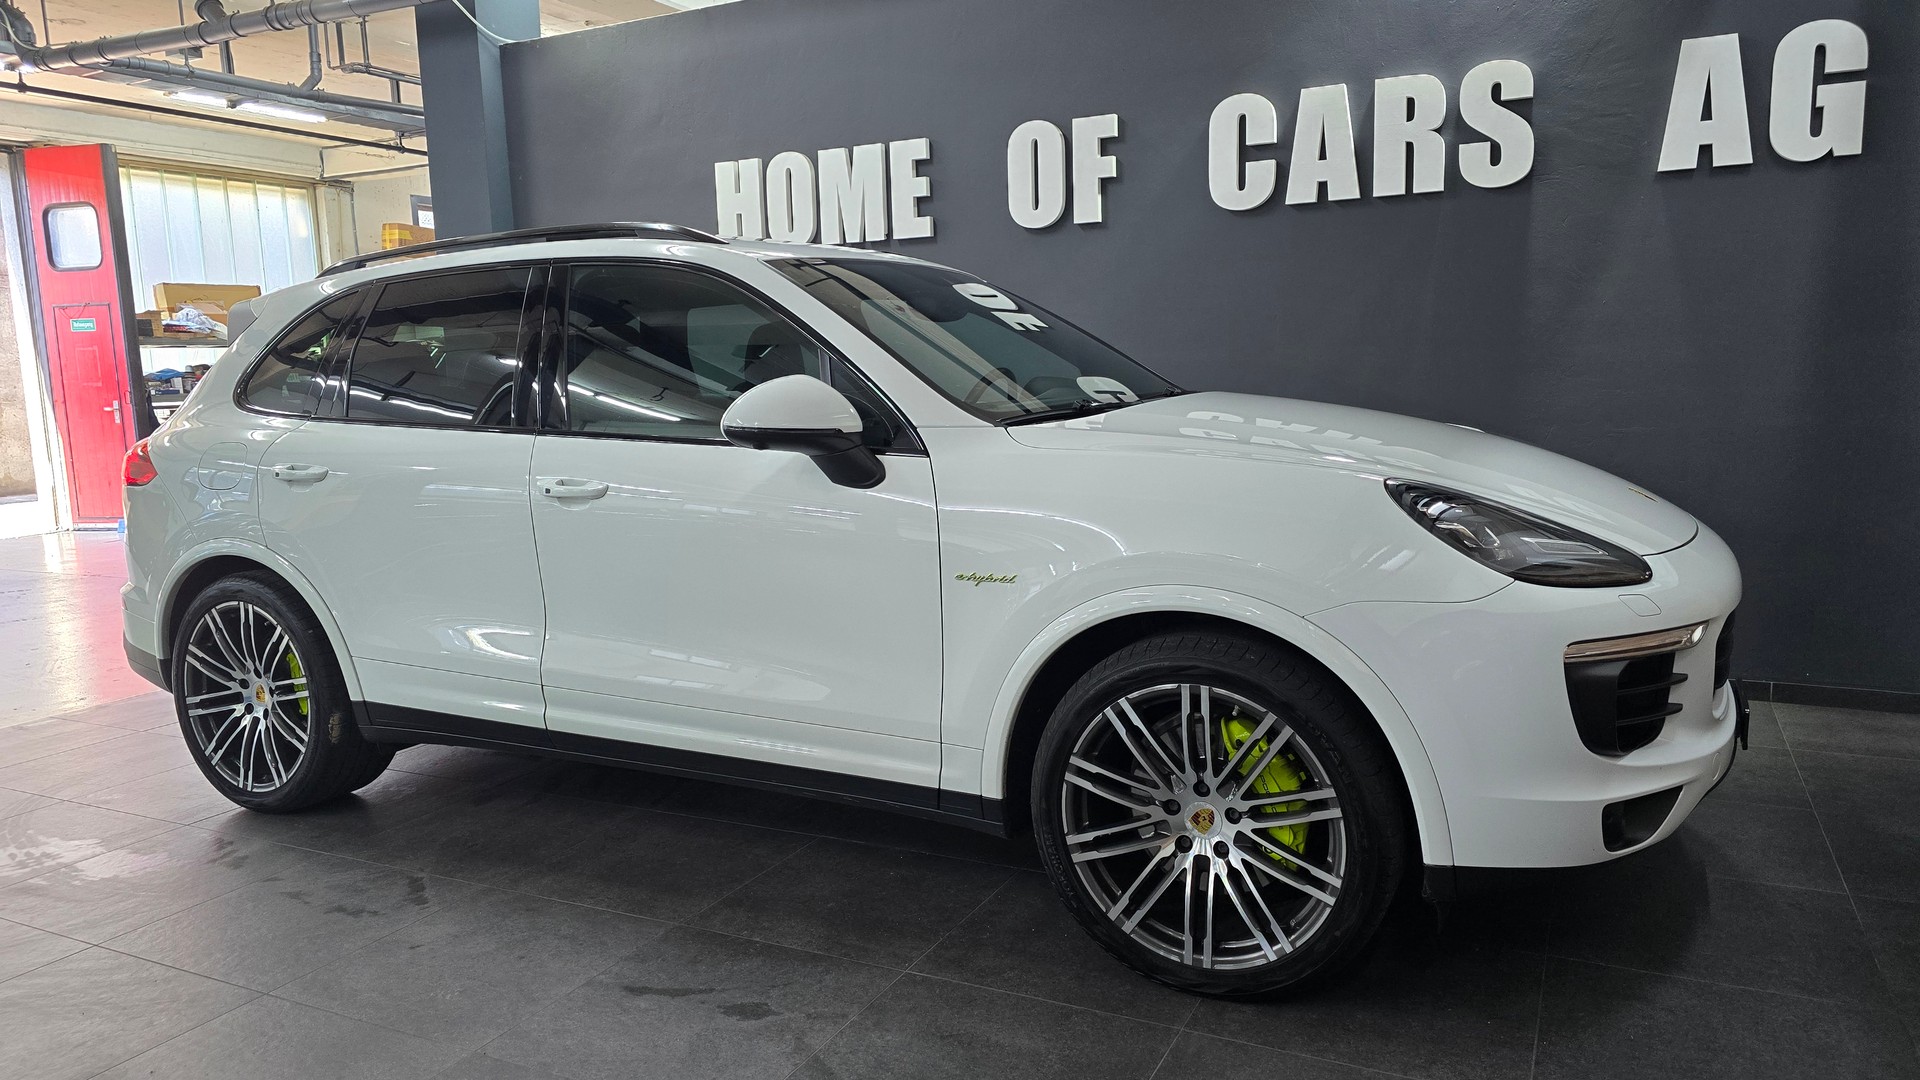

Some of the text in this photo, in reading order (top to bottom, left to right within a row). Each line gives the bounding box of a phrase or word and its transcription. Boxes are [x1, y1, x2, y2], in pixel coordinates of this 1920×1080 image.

[714, 18, 1869, 245] HOME OF CARS AG
